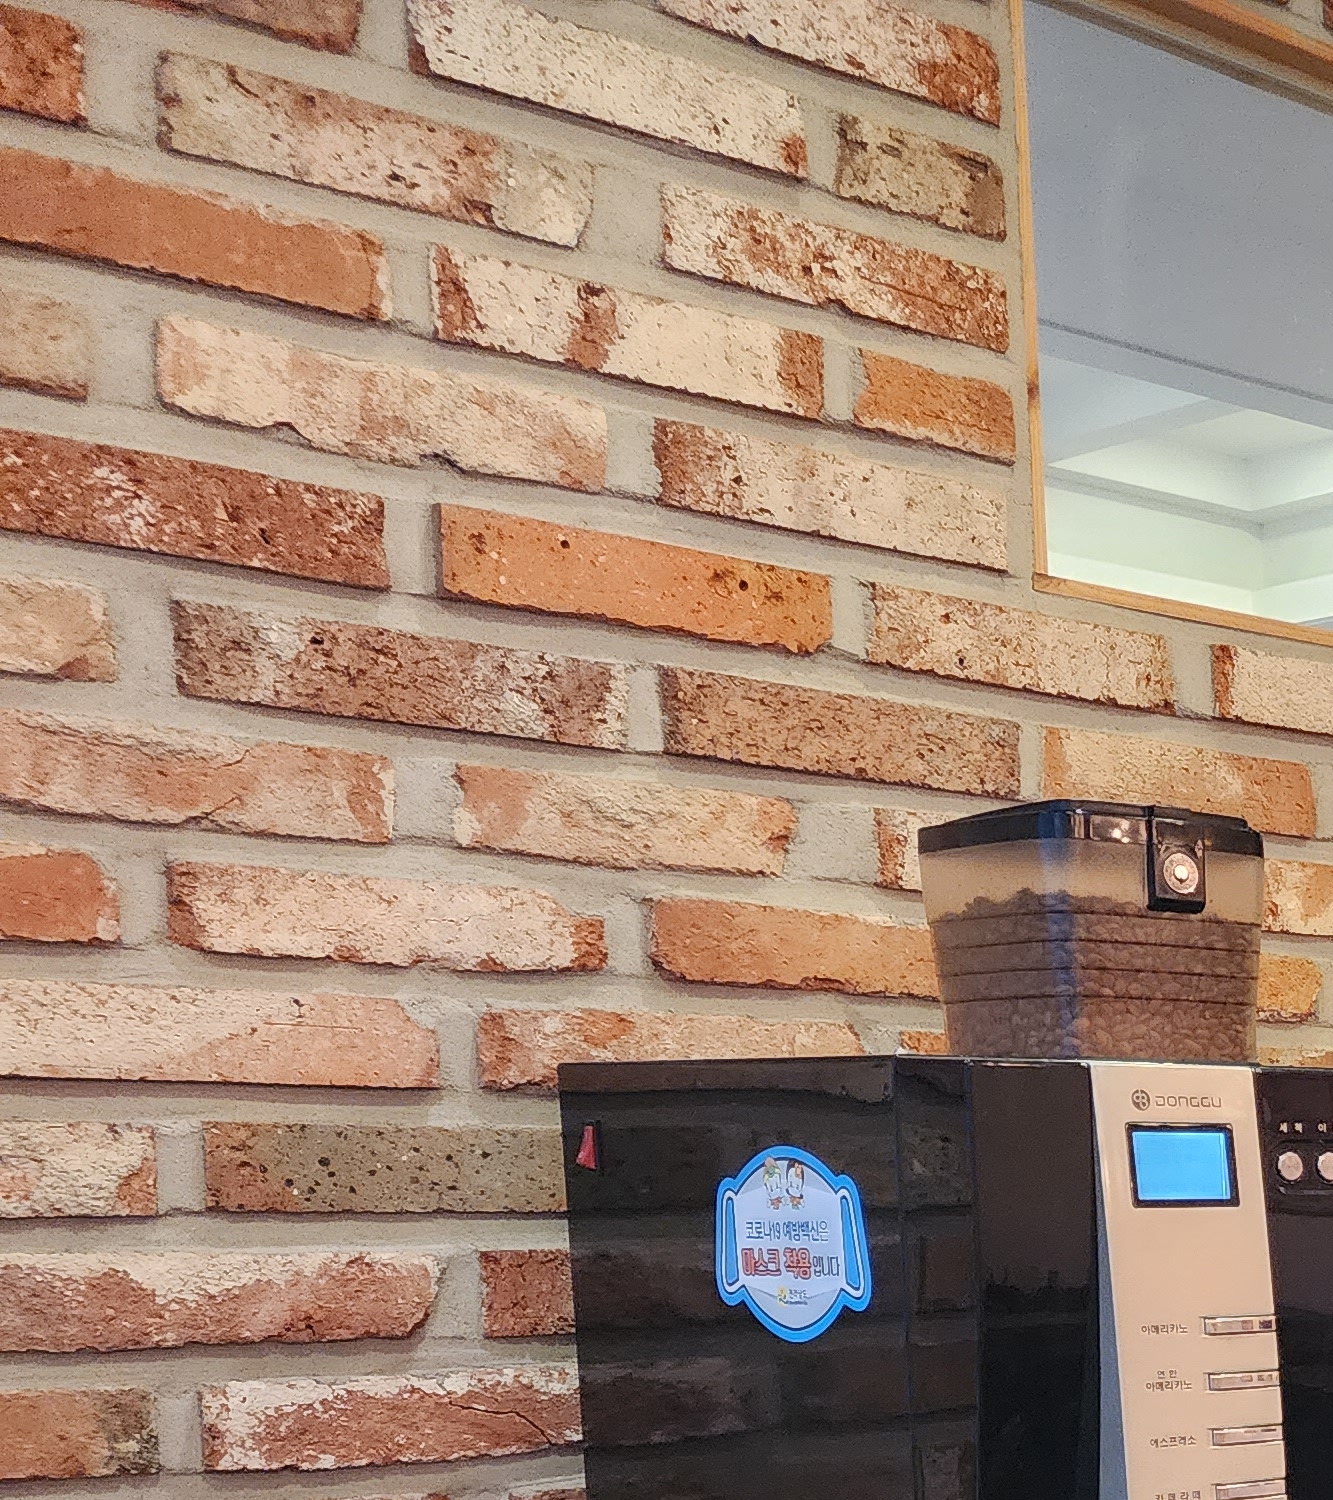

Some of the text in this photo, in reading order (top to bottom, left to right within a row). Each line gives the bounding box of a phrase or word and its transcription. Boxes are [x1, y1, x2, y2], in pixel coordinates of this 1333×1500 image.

[746, 1220, 829, 1242] 코로나19 예방백신은
[742, 1247, 782, 1276] 마스크
[1141, 1324, 1189, 1335] 아메리카노
[1146, 1380, 1193, 1392] 아메리카노
[1150, 1435, 1197, 1448] 에스프레소
